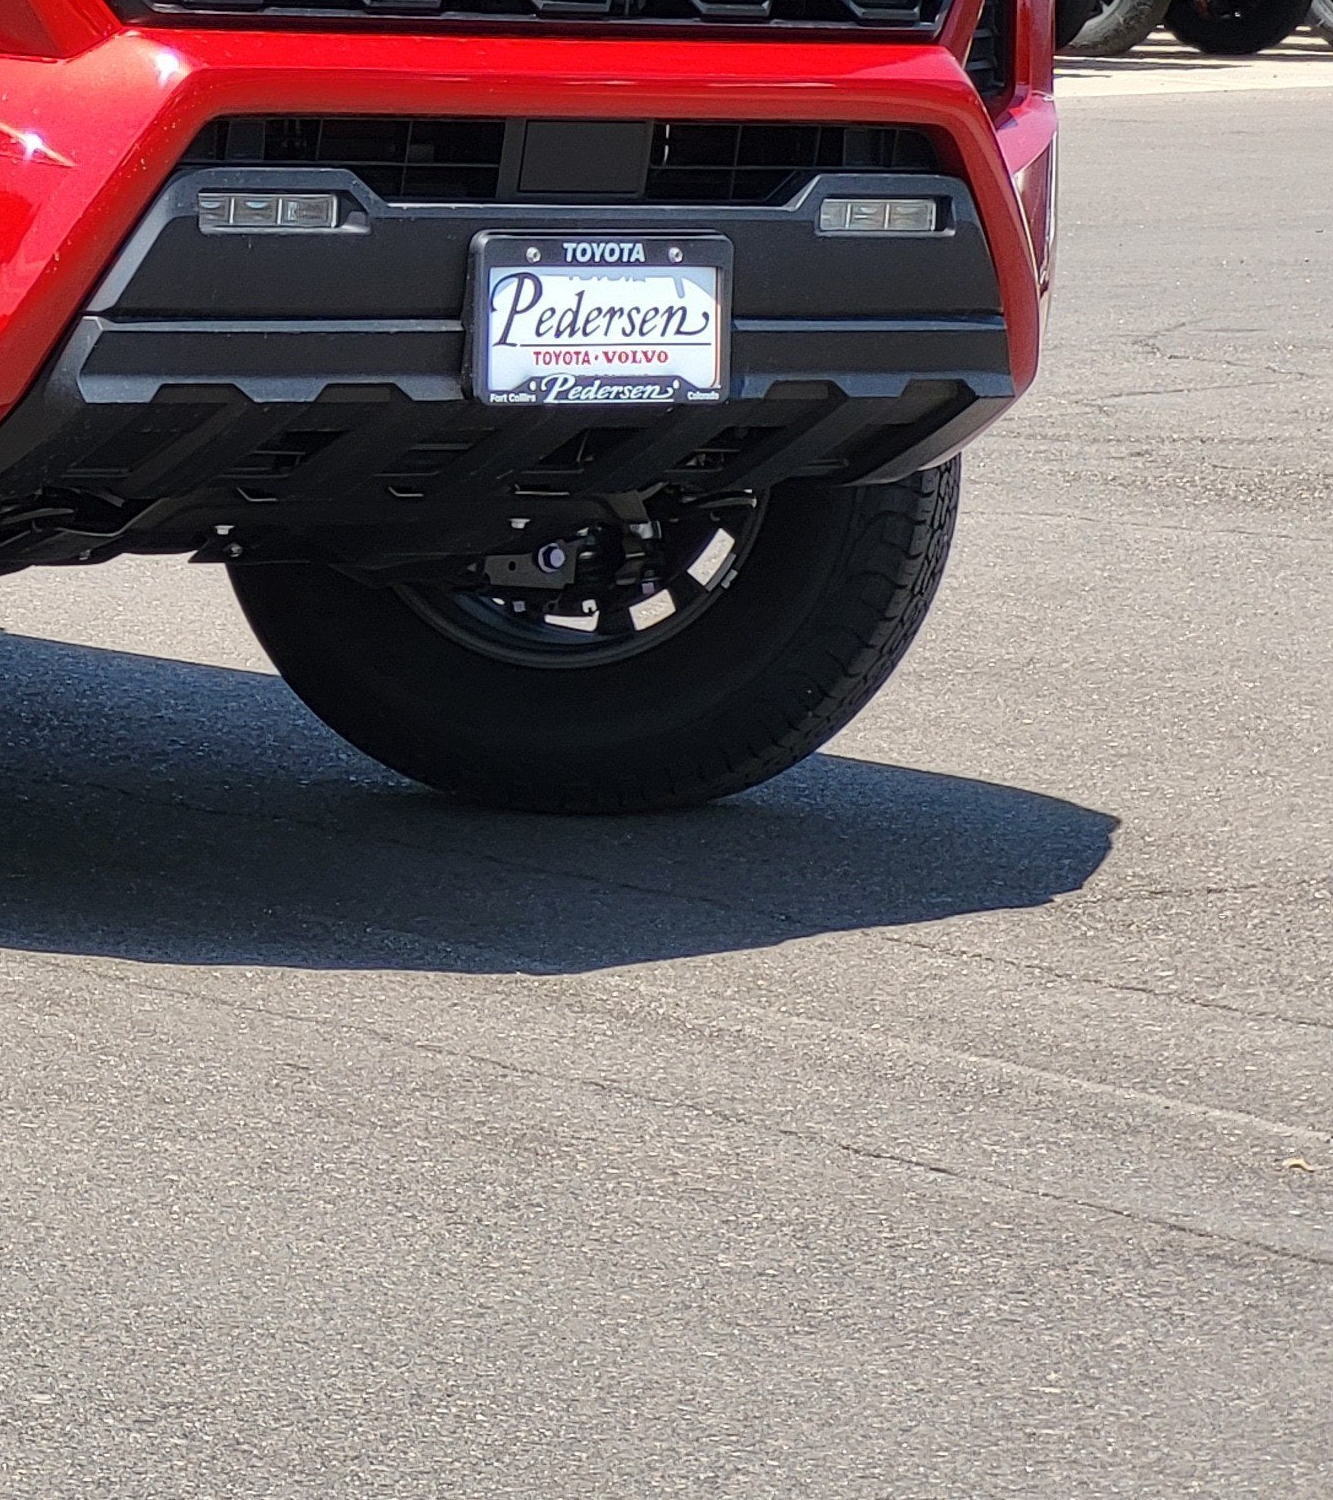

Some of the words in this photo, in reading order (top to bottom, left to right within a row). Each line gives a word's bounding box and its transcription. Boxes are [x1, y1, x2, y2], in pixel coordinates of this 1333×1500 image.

[563, 243, 645, 262] TOYOTA
[491, 271, 710, 347] Pedersen
[533, 351, 591, 365] TOYOTA
[602, 350, 669, 364] VOLVO
[541, 373, 674, 402] Pedersen
